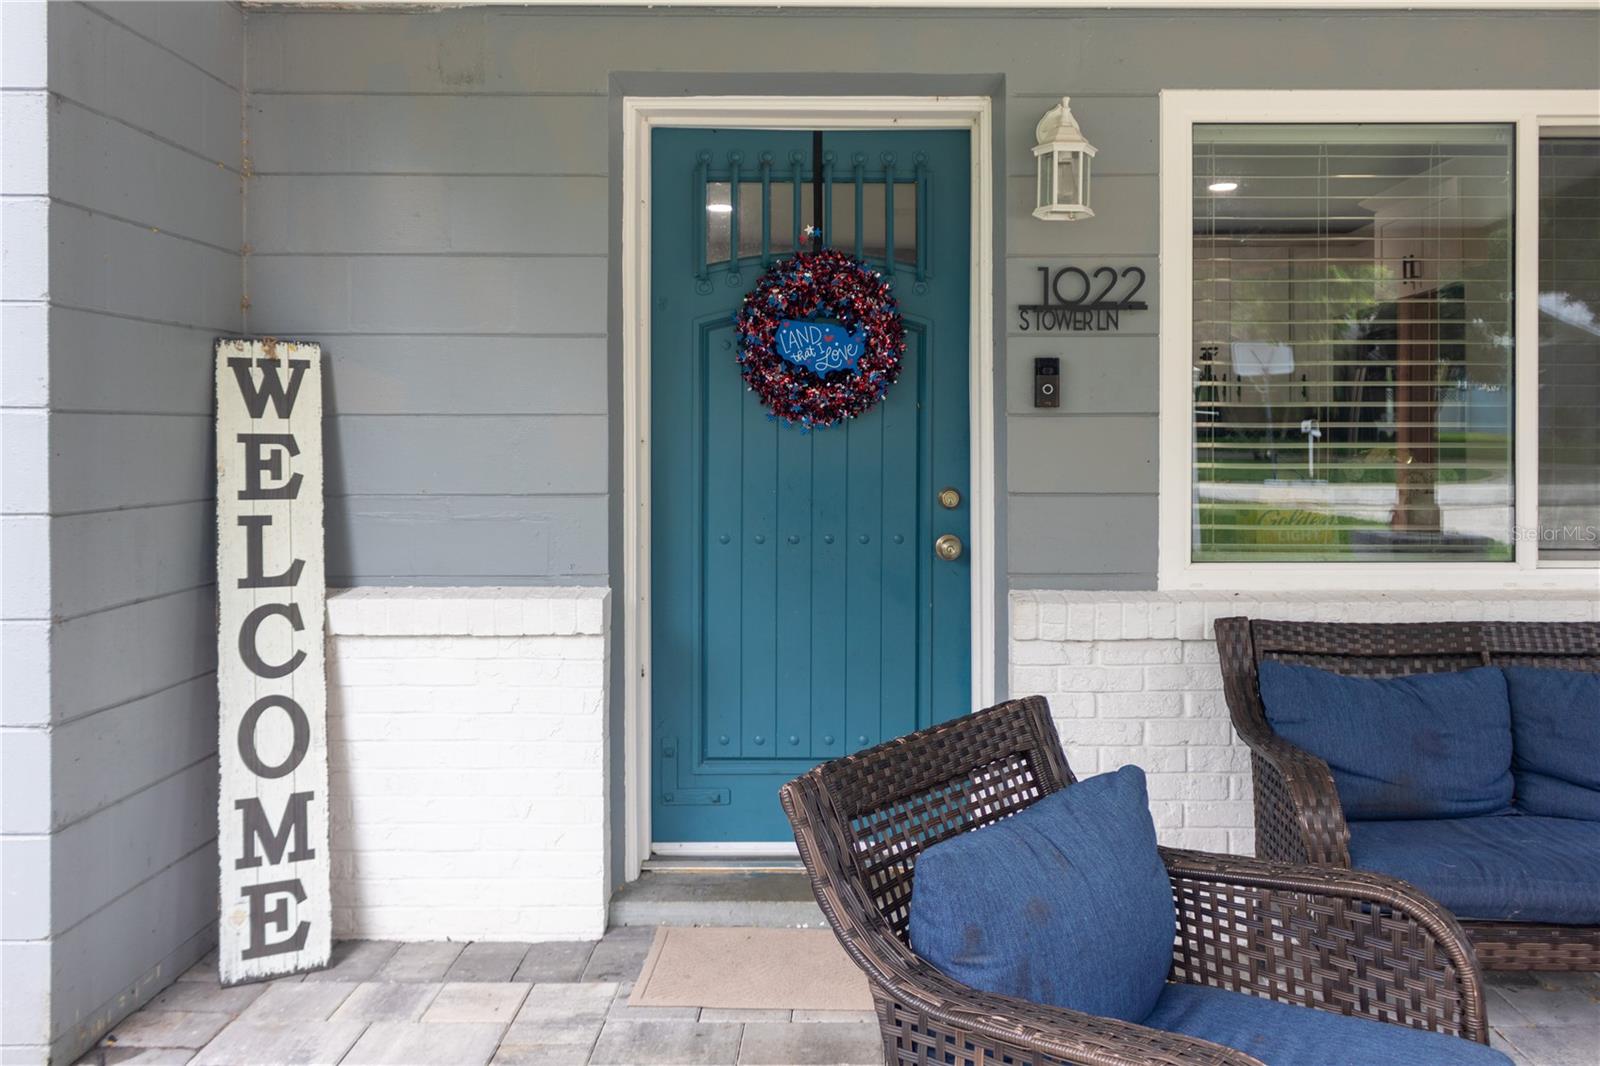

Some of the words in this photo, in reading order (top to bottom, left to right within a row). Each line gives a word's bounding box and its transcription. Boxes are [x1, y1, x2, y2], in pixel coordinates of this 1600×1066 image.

[1037, 266, 1146, 306] 1022
[1018, 309, 1030, 331] S
[1034, 309, 1093, 331] TOWER
[1097, 309, 1119, 331] LN
[780, 326, 822, 354] LAND
[791, 345, 817, 362] that
[815, 343, 859, 371] Love
[227, 357, 316, 961] WELCOME
